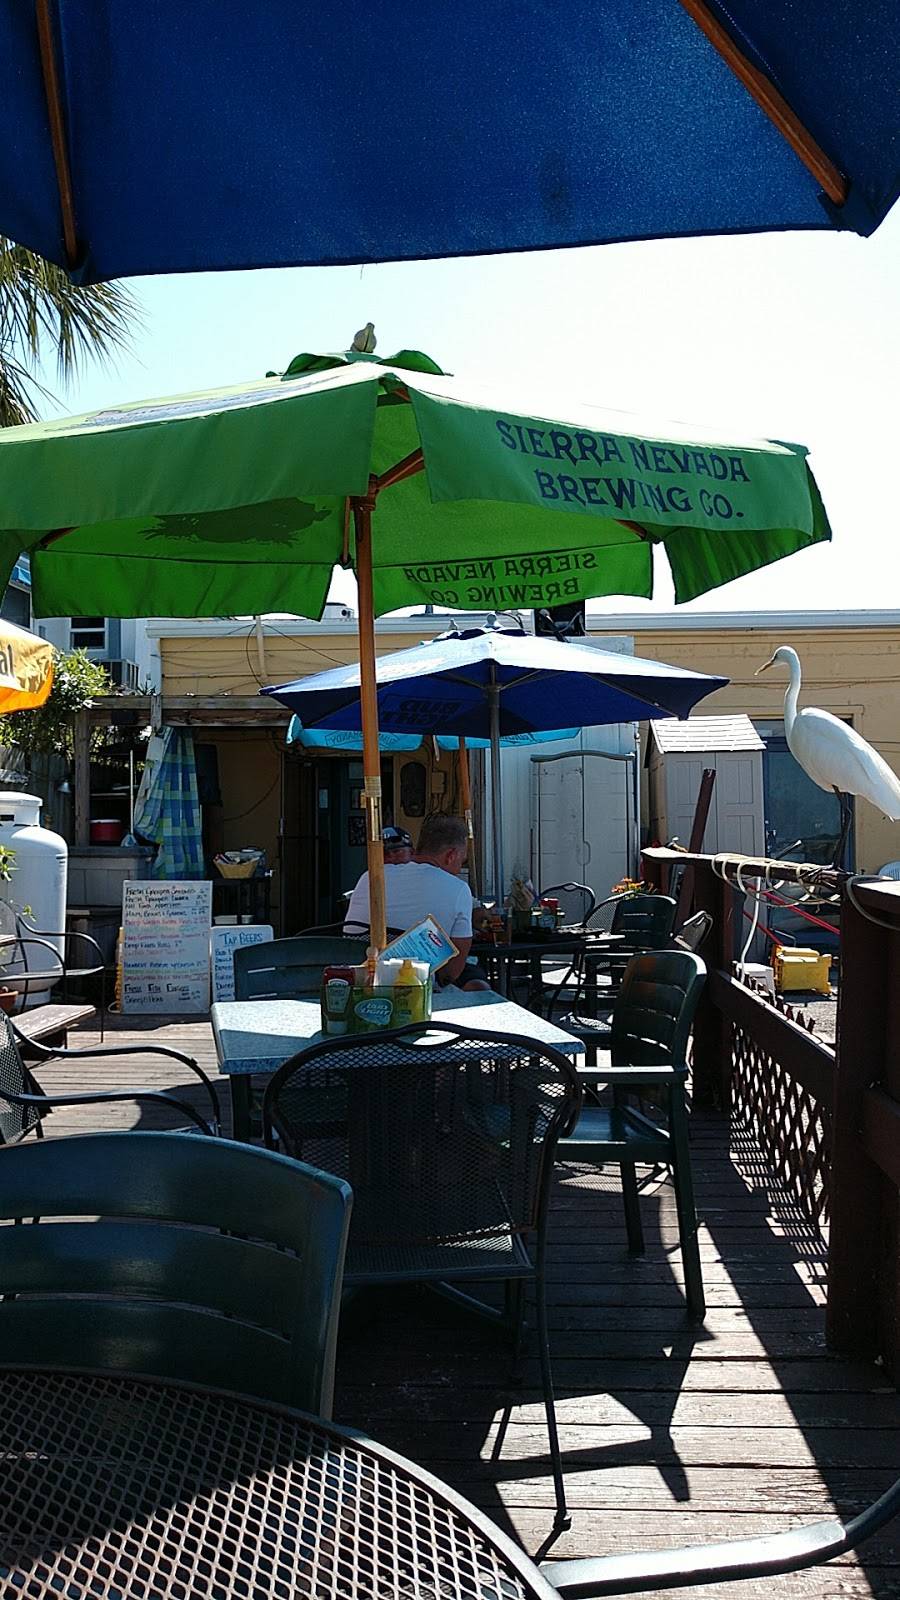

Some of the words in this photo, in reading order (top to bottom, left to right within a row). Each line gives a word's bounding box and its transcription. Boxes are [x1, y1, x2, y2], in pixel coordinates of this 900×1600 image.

[495, 418, 626, 467] SIERRA
[629, 440, 751, 483] NEVADA
[534, 468, 694, 515] BREWING
[699, 487, 745, 519] CO.
[218, 932, 238, 946] TAP
[239, 931, 263, 945] BEERS
